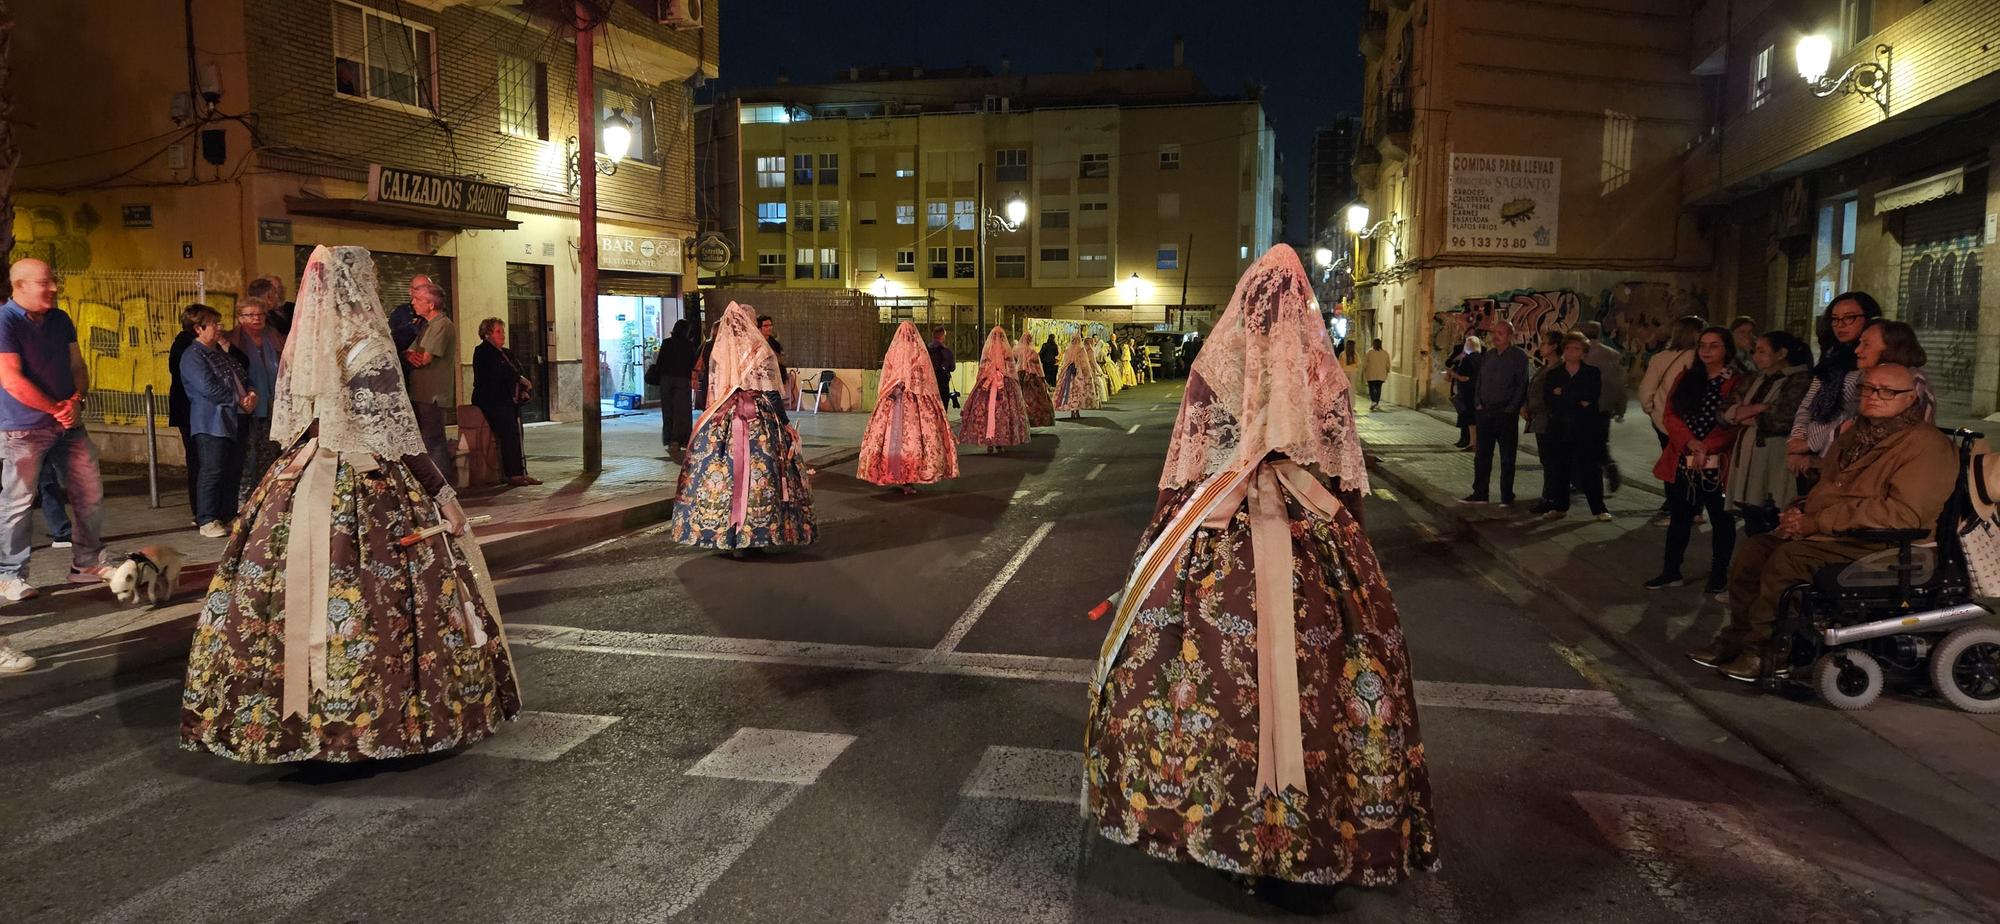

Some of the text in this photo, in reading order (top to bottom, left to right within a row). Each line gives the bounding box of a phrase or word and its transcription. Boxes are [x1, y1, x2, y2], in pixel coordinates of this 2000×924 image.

[1453, 157, 1554, 174] COMIDAS PARA LLEVAR
[1495, 176, 1551, 192] SAGUNTO
[380, 169, 508, 216] CALZADOS SAGUNTO
[1453, 195, 1494, 203] CALDERETAS
[1453, 215, 1489, 223] ENSALADAS
[1453, 222, 1476, 230] PLATOS
[602, 238, 635, 253] BAR
[1451, 236, 1466, 247] 96
[1471, 236, 1491, 248] 133
[1495, 237, 1509, 248] 73
[184, 246, 191, 258] 2
[602, 257, 657, 267] RESTAURANTE
